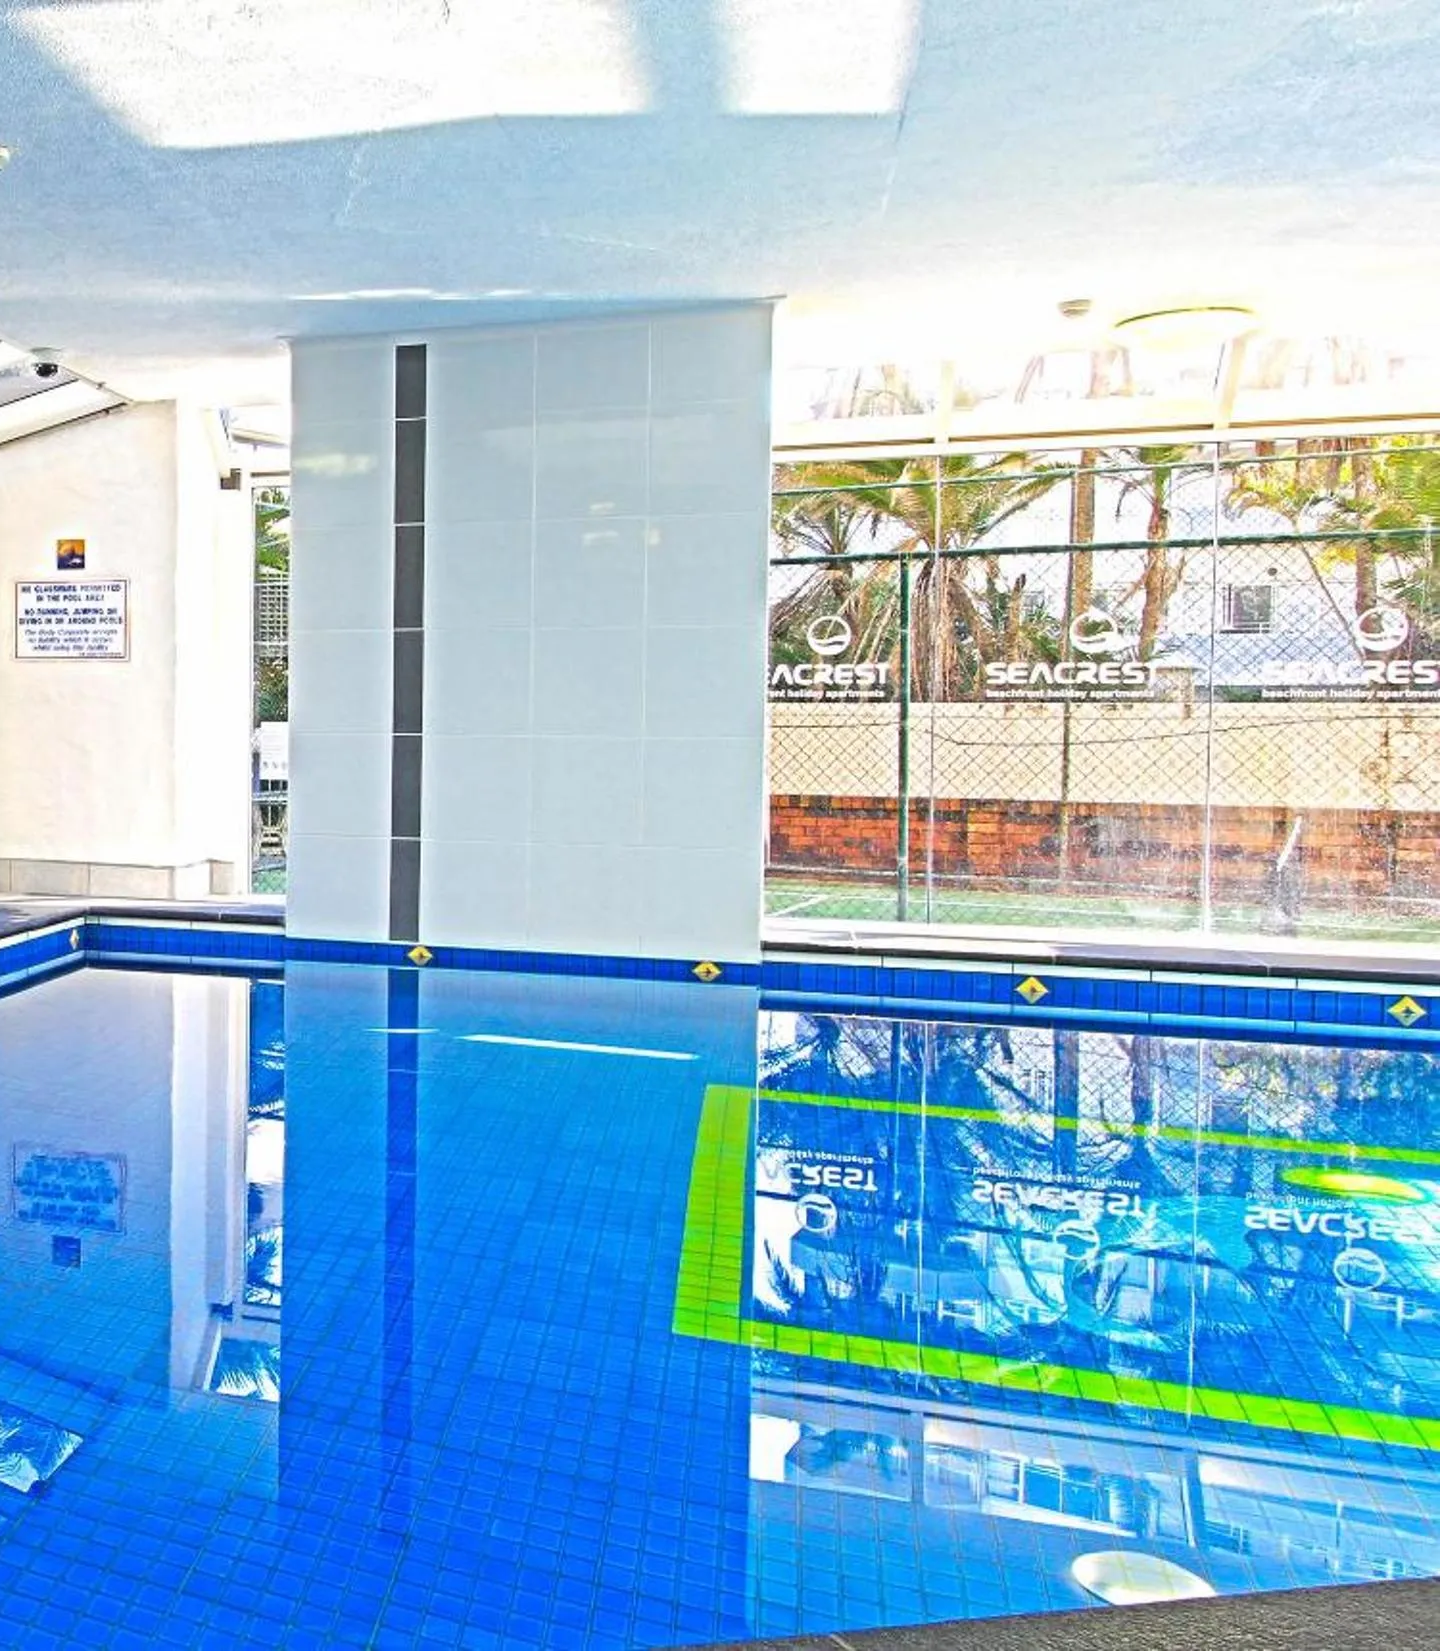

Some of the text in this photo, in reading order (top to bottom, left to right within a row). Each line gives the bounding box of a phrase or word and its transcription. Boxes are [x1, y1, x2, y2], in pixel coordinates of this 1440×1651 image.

[766, 663, 890, 685] ACREST
[984, 661, 1158, 689] SEACREST
[1260, 658, 1440, 685] SEACRES
[1376, 689, 1440, 700] apartmen
